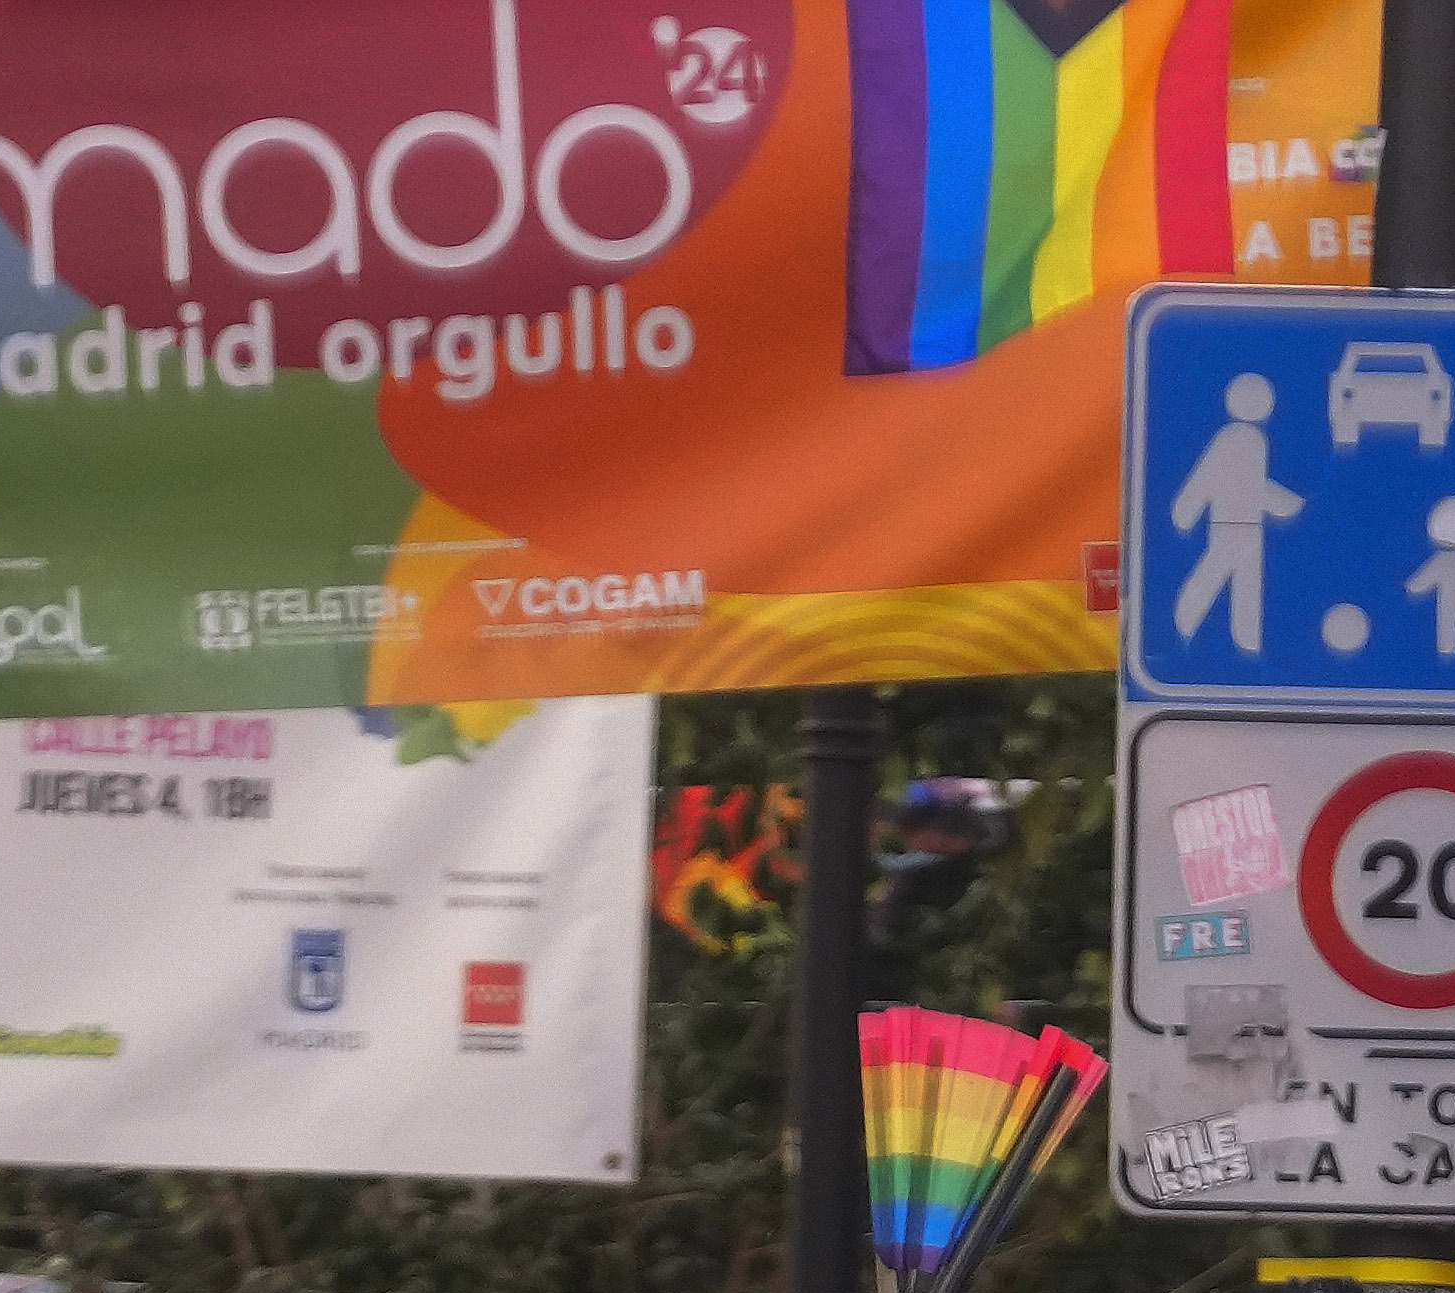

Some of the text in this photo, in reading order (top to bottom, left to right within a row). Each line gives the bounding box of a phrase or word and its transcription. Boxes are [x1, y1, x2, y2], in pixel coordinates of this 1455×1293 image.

[320, 284, 696, 402] orgullo
[520, 570, 705, 616] COGAM
[18, 771, 147, 816] JUEVES
[1163, 917, 1244, 954] FRE
